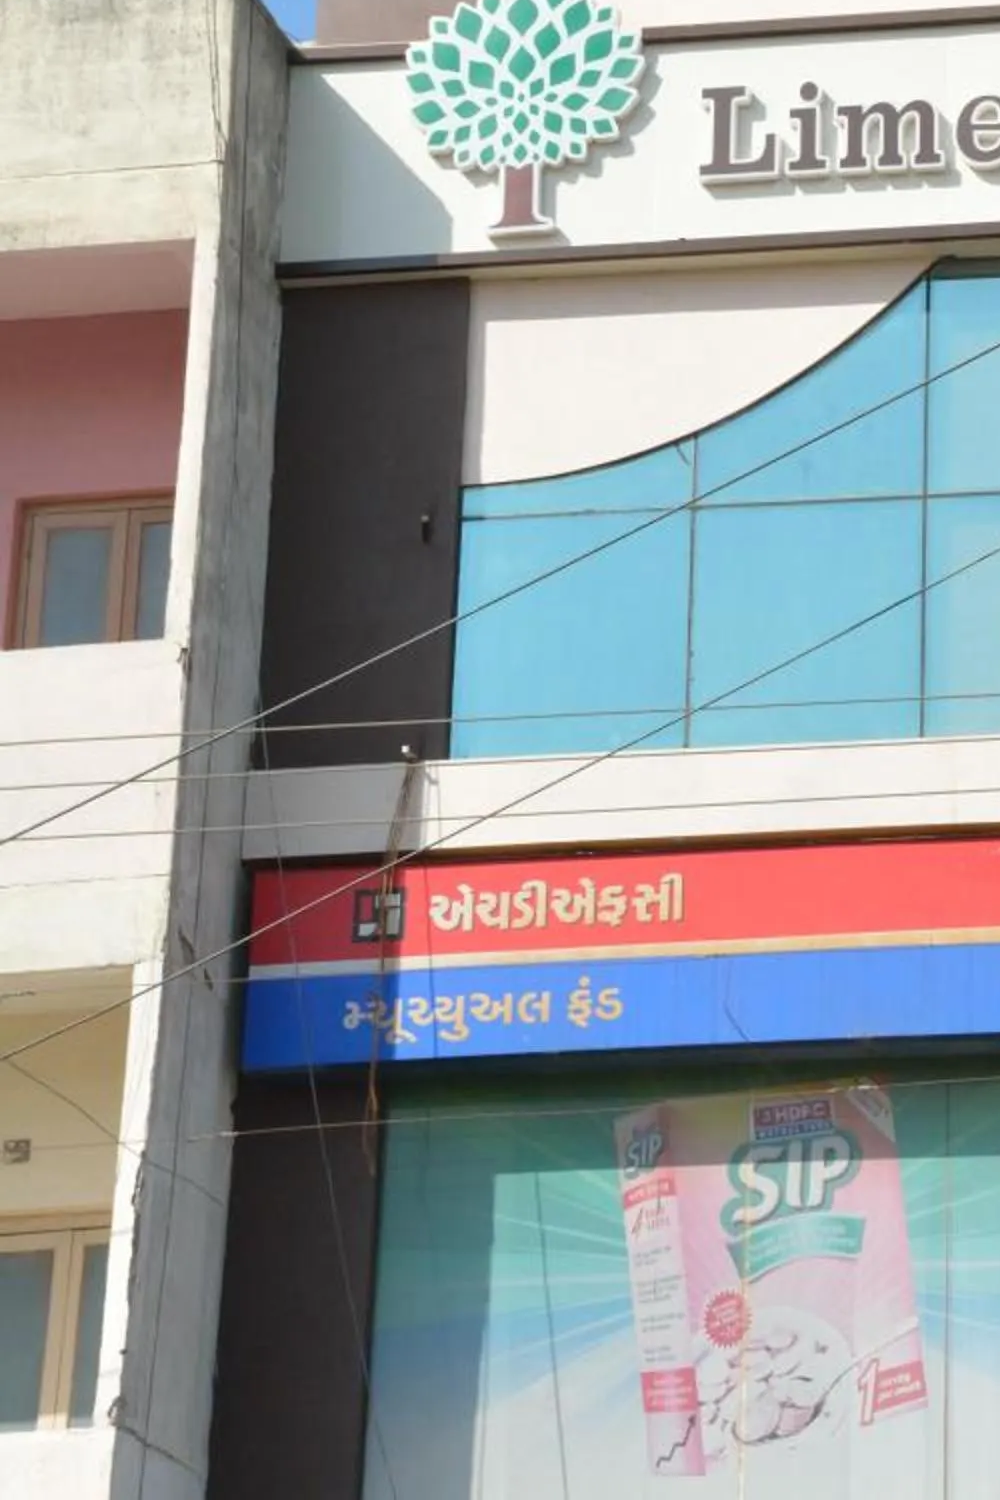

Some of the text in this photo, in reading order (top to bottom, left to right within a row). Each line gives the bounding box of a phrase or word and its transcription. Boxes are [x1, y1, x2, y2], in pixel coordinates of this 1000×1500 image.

[428, 872, 685, 933] એચડીએફસી
[566, 975, 624, 1028] ફંડ
[625, 1133, 663, 1173] SIP
[732, 1135, 852, 1224] SIP
